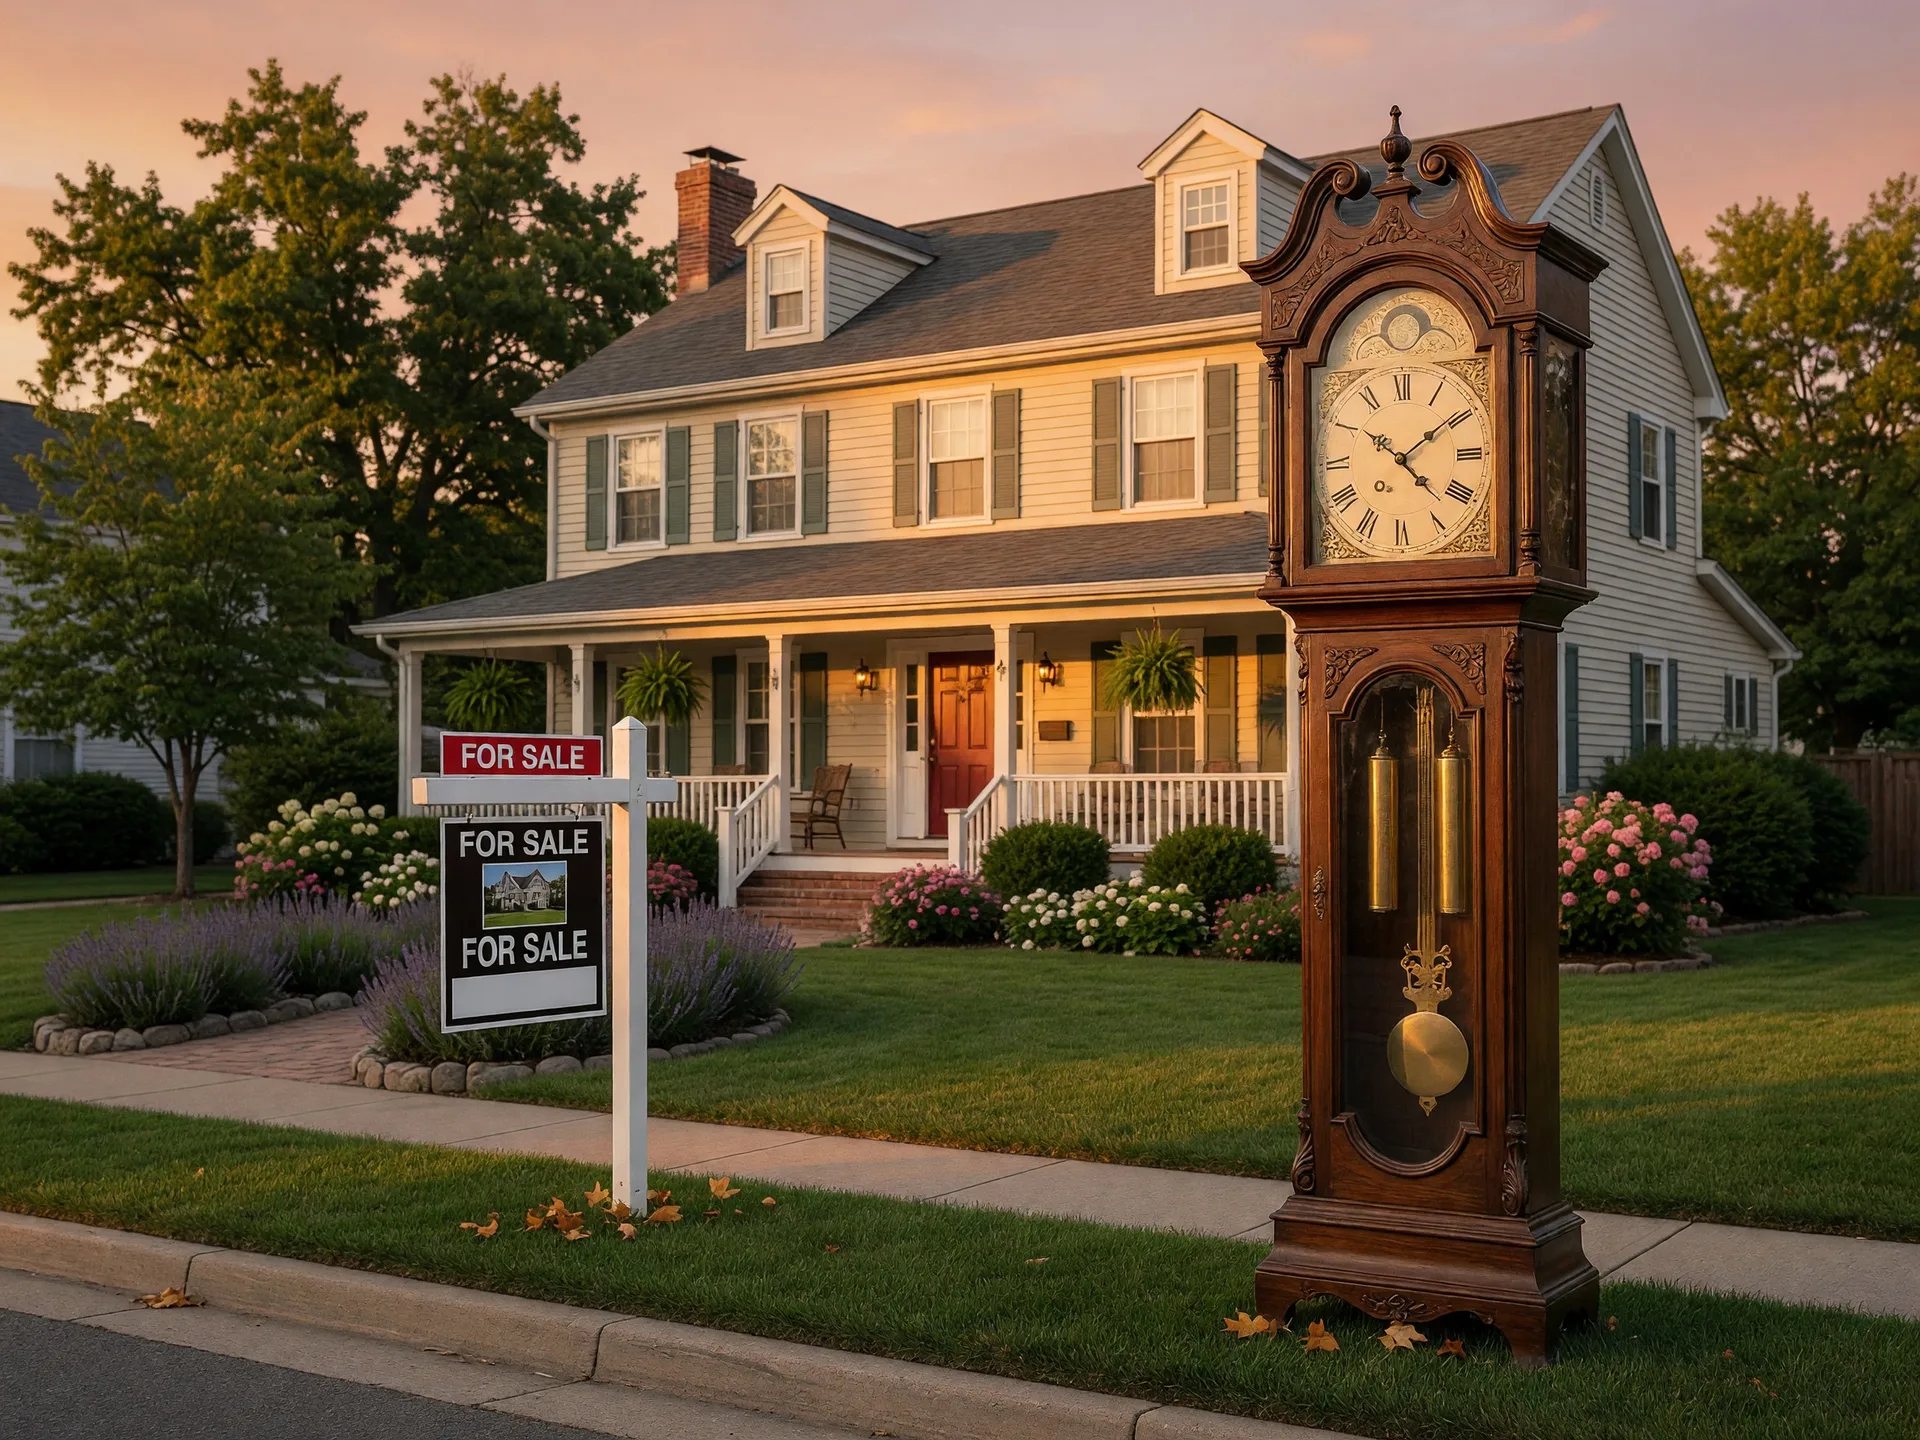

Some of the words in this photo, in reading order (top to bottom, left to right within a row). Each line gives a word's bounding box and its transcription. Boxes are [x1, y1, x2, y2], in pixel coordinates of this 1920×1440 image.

[1358, 385, 1380, 415] XI
[1392, 373, 1411, 402] XII
[1448, 408, 1473, 429] II
[1457, 447, 1483, 462] III
[1331, 484, 1358, 514] VIII
[1356, 507, 1380, 540] VII
[1395, 519, 1410, 546] VI
[1430, 511, 1447, 535] V
[461, 743, 514, 769] FOR
[521, 744, 585, 770] SALE
[460, 830, 515, 858] FOR
[522, 828, 589, 856] SALE
[462, 935, 516, 969] FOR
[522, 929, 588, 964] SALE
